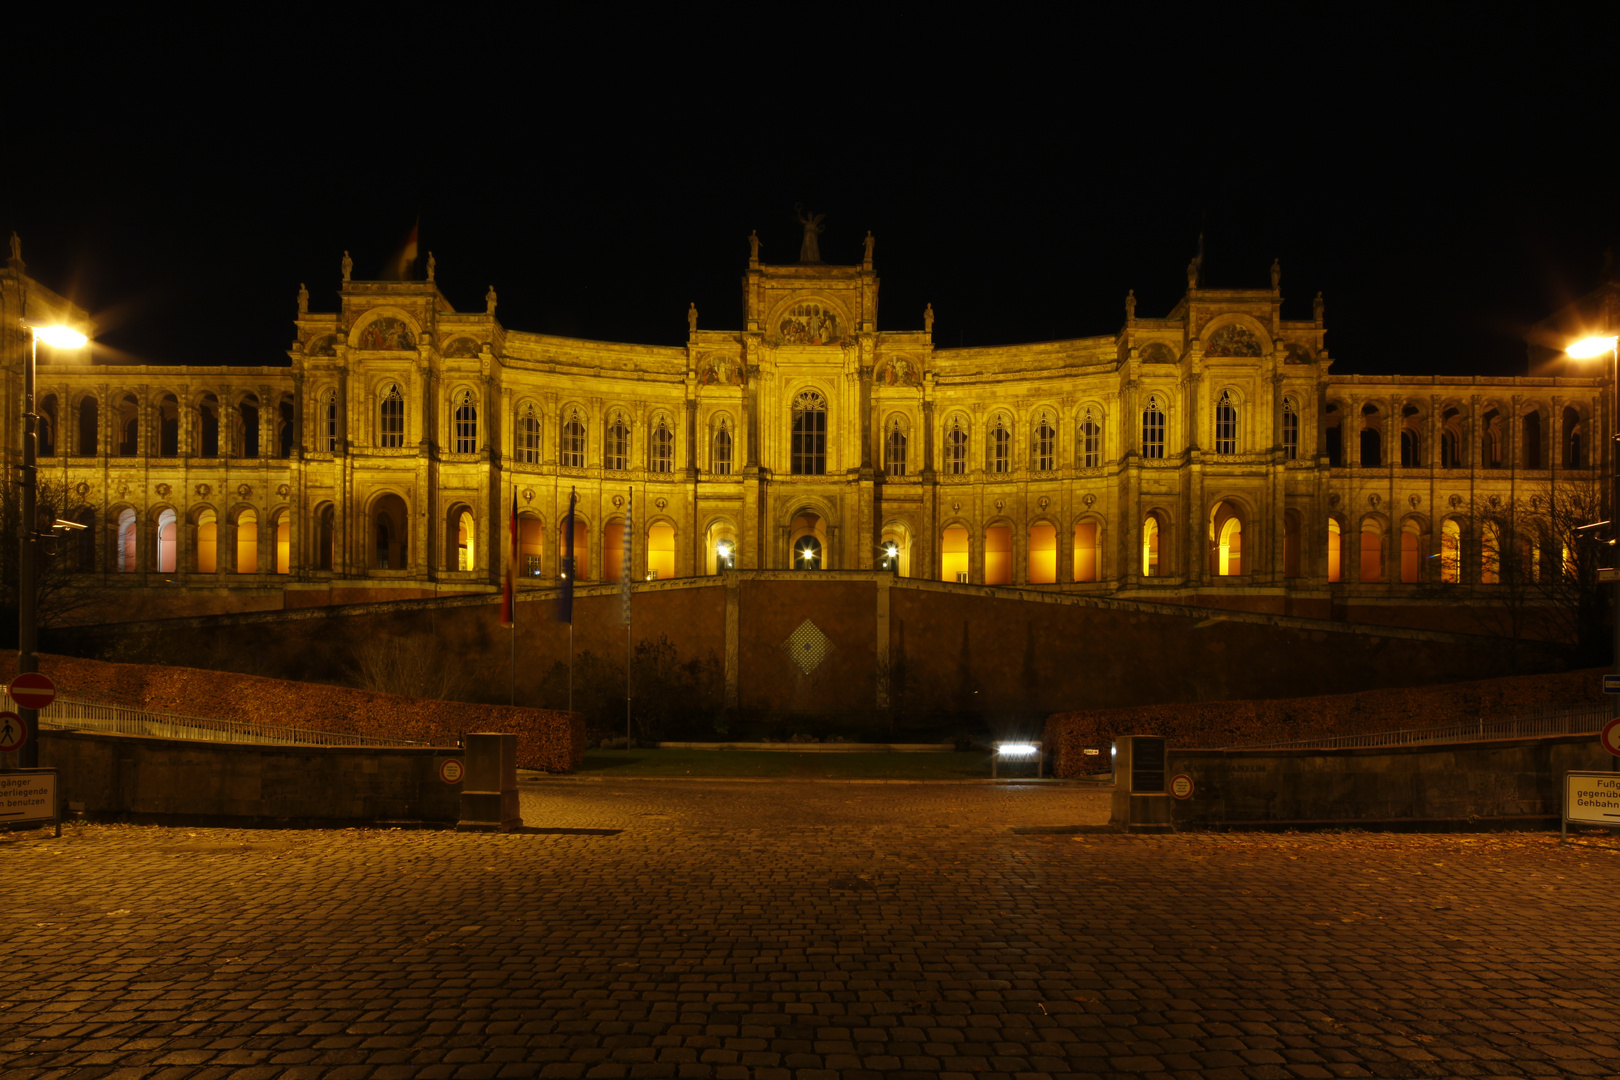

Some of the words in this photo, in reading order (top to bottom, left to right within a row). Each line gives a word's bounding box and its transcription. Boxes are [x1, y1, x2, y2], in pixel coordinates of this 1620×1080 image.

[1, 778, 31, 788] gänger
[1577, 790, 1620, 798] gegenüb
[7, 798, 45, 807] benutzen
[1577, 798, 1620, 808] Gehbahn
